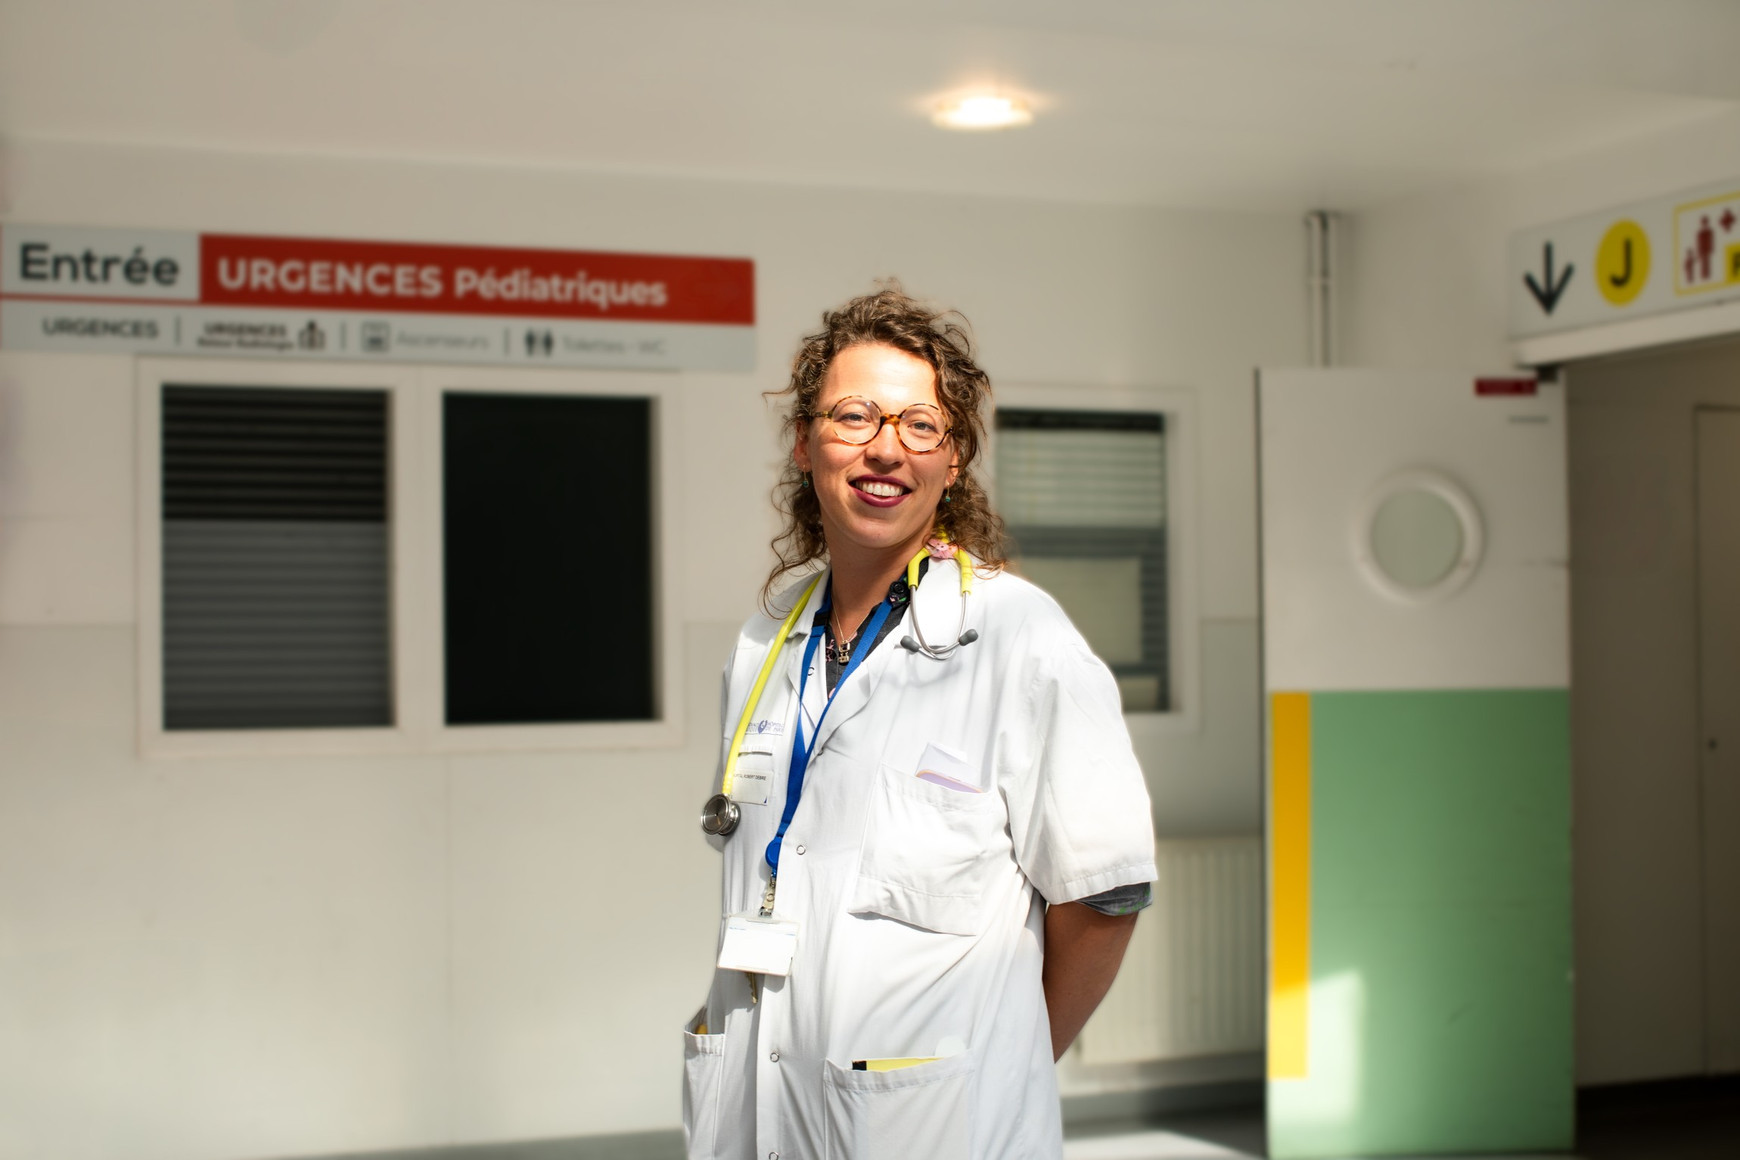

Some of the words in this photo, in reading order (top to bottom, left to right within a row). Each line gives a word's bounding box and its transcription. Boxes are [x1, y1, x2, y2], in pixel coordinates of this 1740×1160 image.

[20, 242, 179, 286] Entrée
[217, 257, 443, 297] URGENCES
[455, 266, 668, 310] Pédiatriques
[1609, 237, 1633, 289] J
[42, 317, 158, 338] URGENCES
